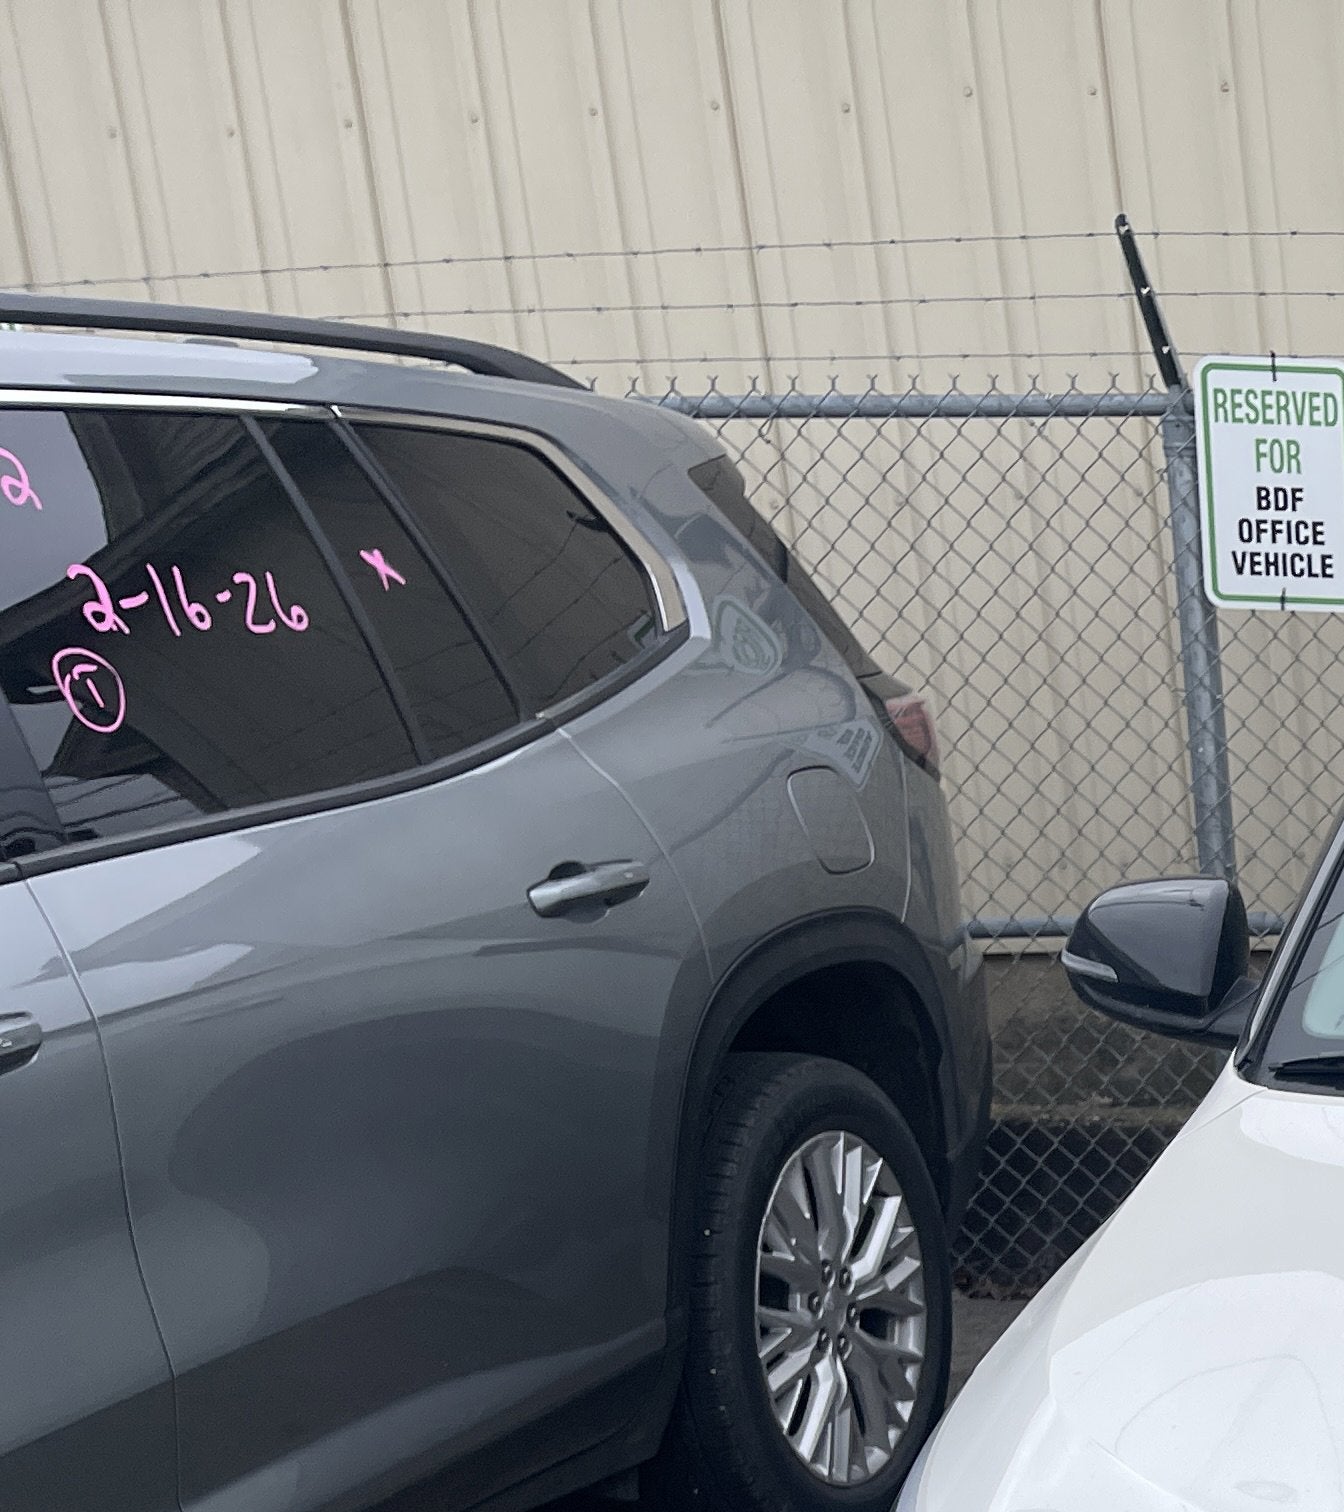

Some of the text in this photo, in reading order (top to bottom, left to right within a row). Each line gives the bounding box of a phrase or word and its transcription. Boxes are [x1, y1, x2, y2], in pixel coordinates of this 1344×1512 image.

[1213, 388, 1339, 427] RESERVED
[1254, 438, 1302, 475] FOR
[1256, 486, 1304, 512] BDF
[1238, 518, 1326, 546] OFFICE
[1231, 550, 1334, 579] VEHICLE
[66, 563, 310, 637] 2-16-26
